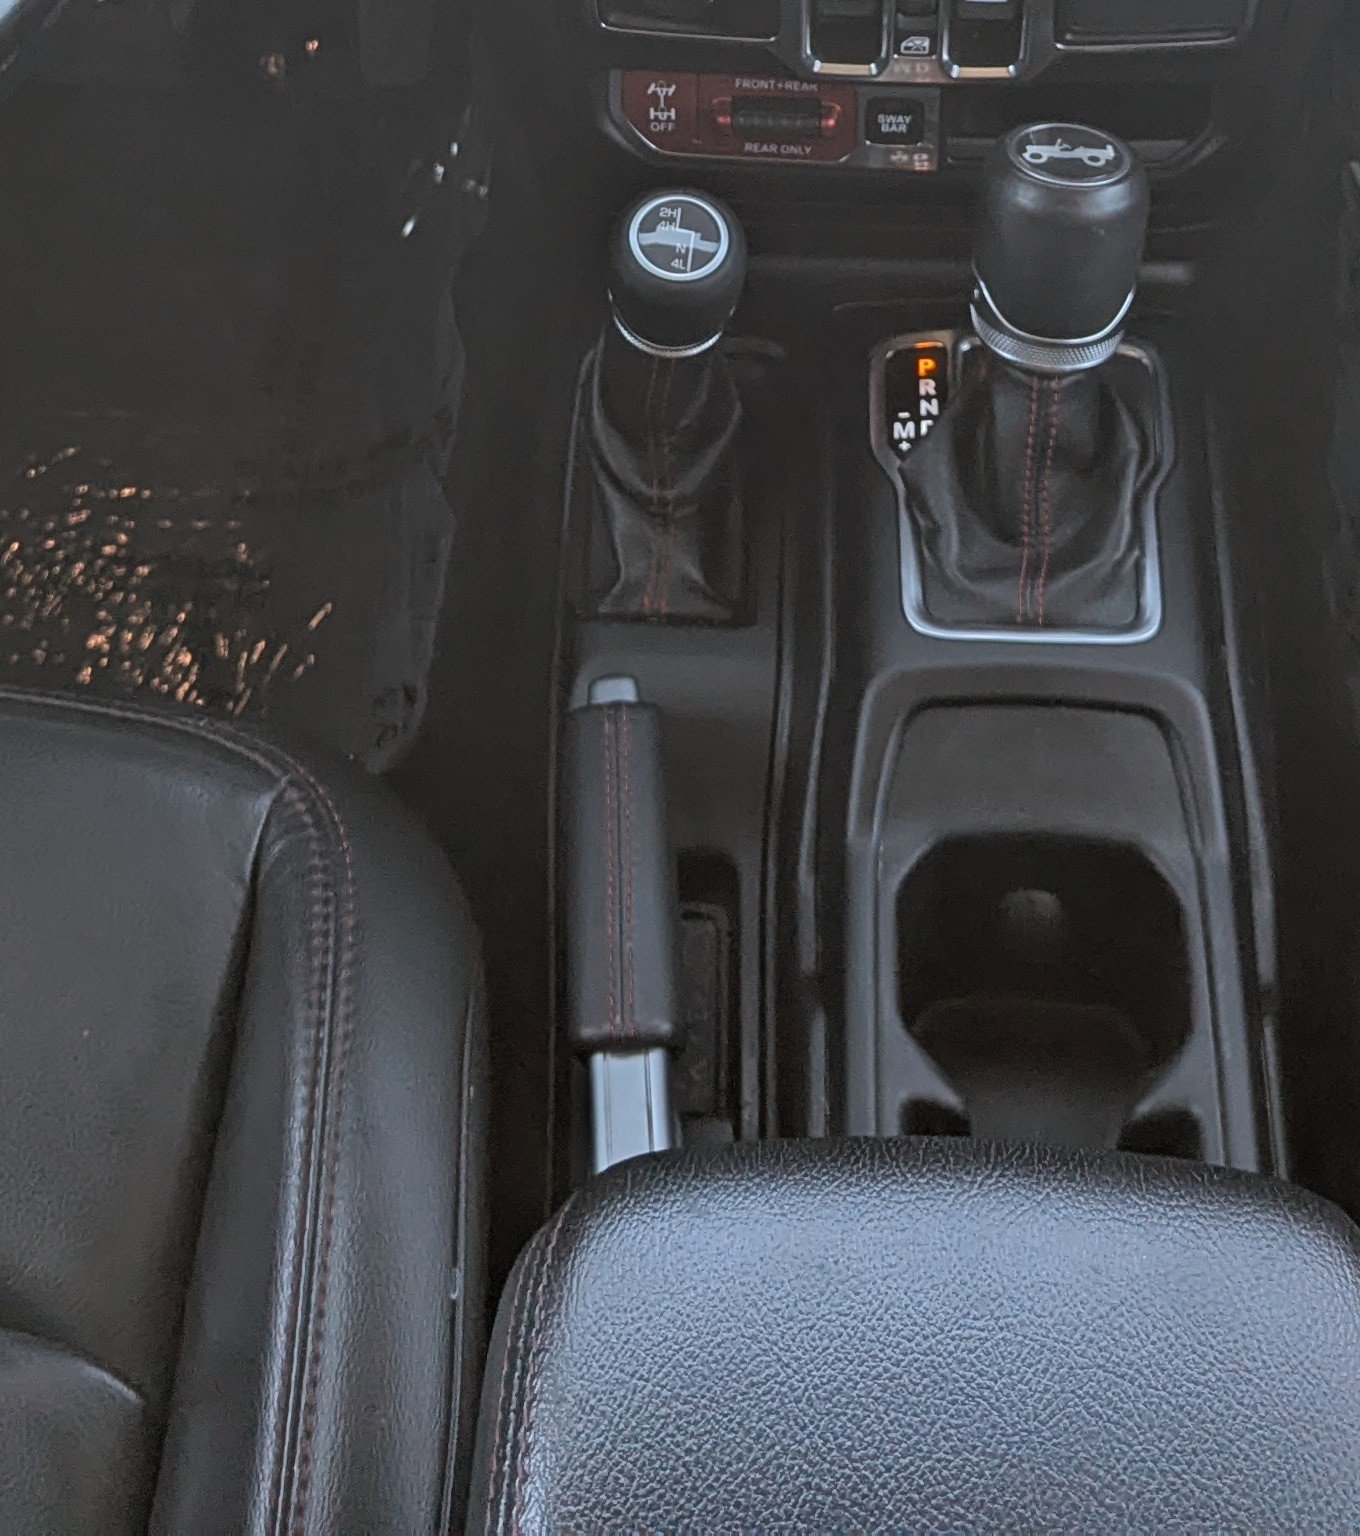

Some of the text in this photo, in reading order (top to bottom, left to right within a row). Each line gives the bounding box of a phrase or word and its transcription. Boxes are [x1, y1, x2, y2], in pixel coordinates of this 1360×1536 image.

[734, 77, 776, 90] FRONT
[649, 122, 676, 132] OFF
[743, 141, 779, 153] REAR
[659, 207, 677, 218] 2H
[670, 258, 686, 270] 4L
[918, 357, 937, 376] P
[919, 378, 937, 396] R
[920, 397, 939, 416] N
[893, 420, 916, 439] M
